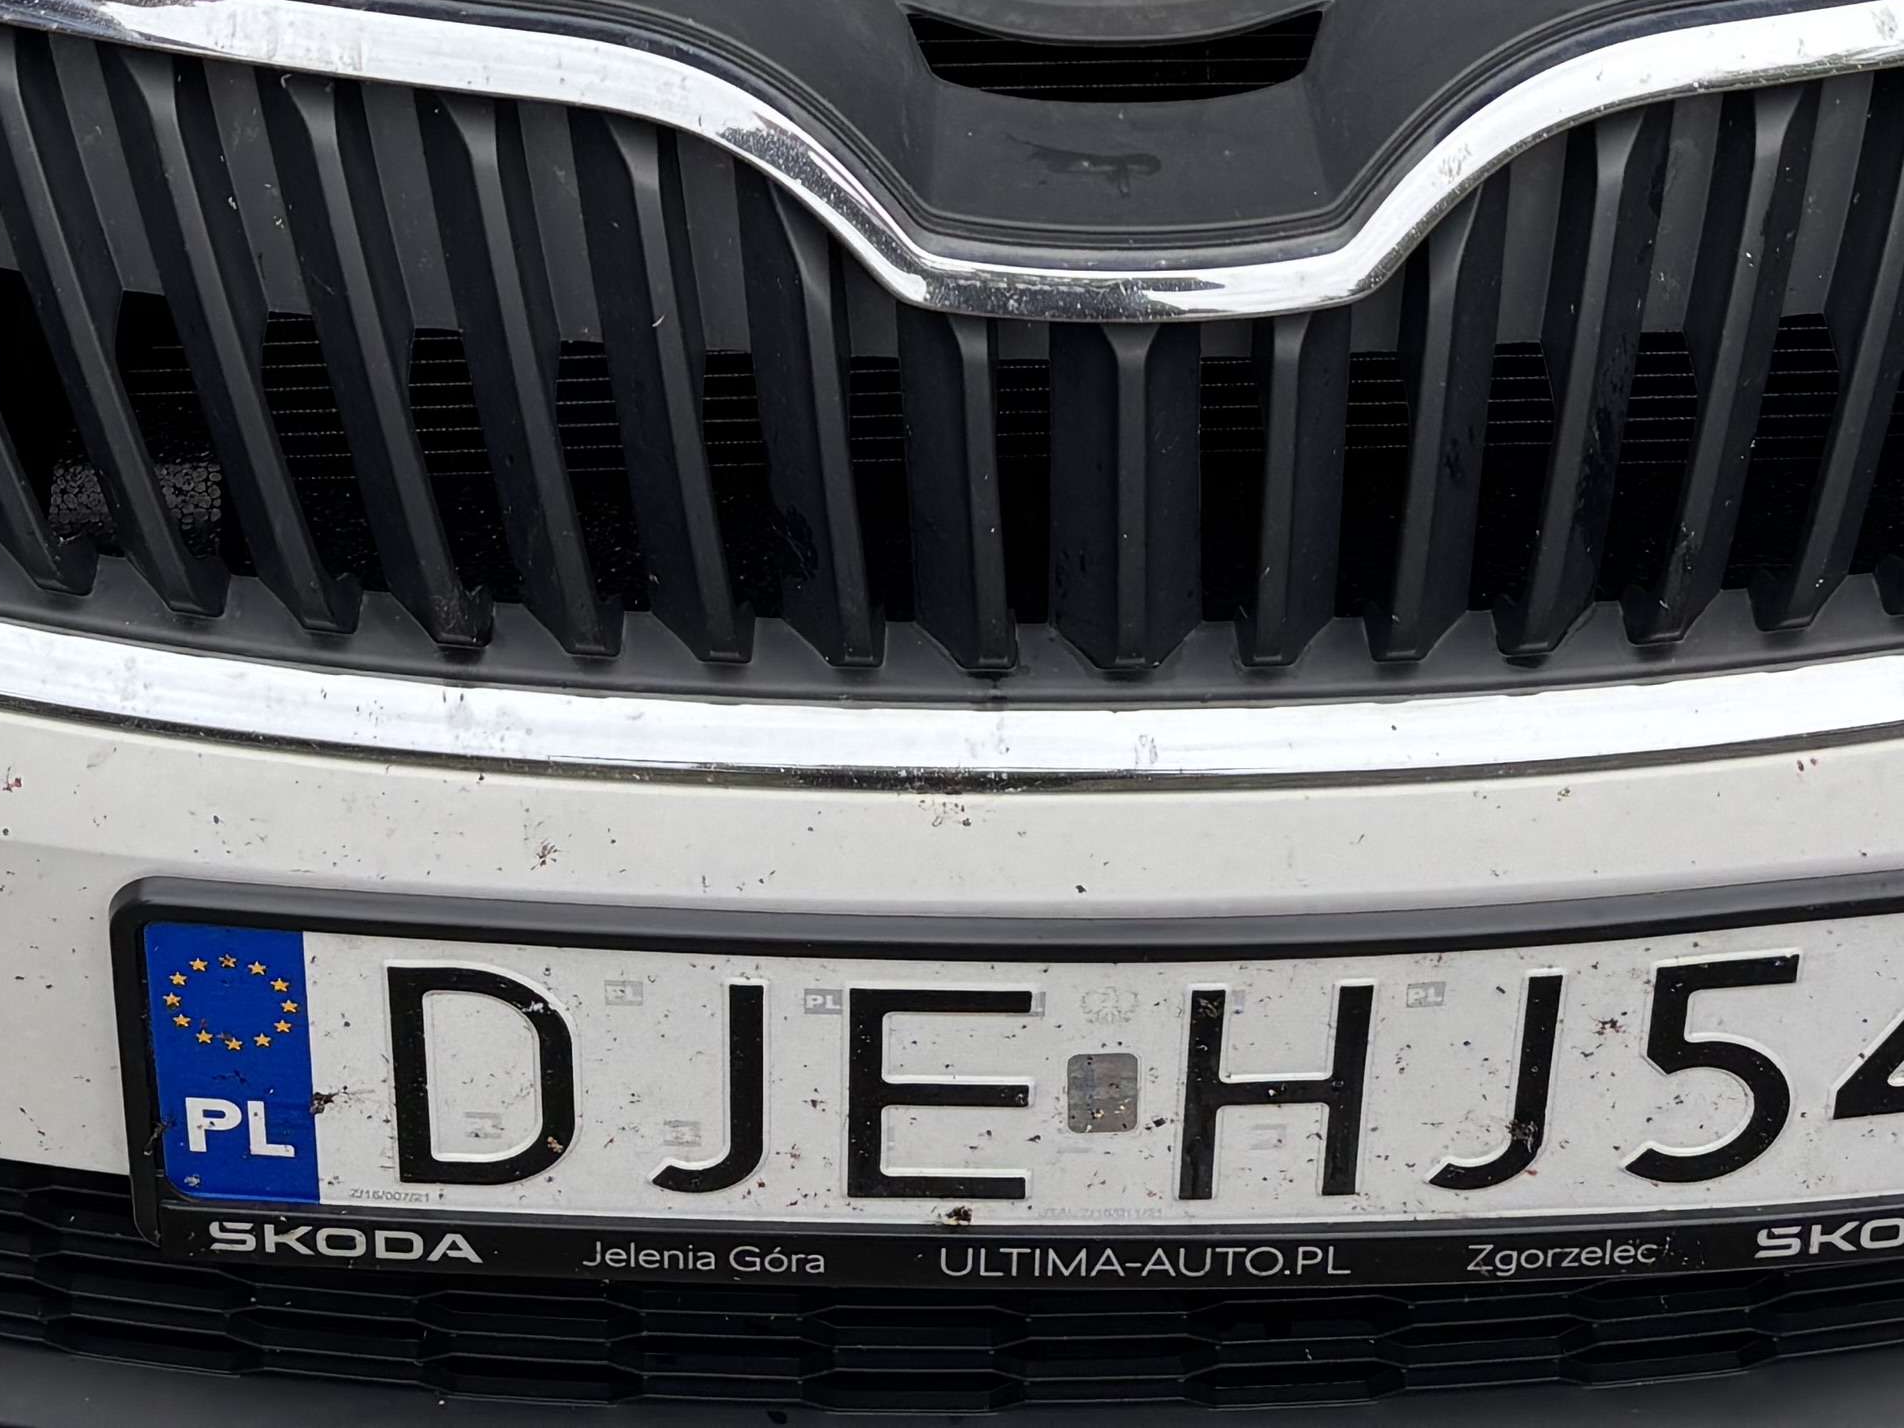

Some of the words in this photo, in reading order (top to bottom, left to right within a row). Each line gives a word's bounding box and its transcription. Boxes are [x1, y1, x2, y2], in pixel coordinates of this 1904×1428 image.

[387, 965, 1033, 1199] DJE
[185, 1097, 295, 1158] PL
[582, 1240, 716, 1271] Jelenia
[729, 1246, 825, 1274] Góra
[939, 1246, 1351, 1278] ULTIMA-AUTO.PL
[1466, 1242, 1658, 1277] Zgorzelec
